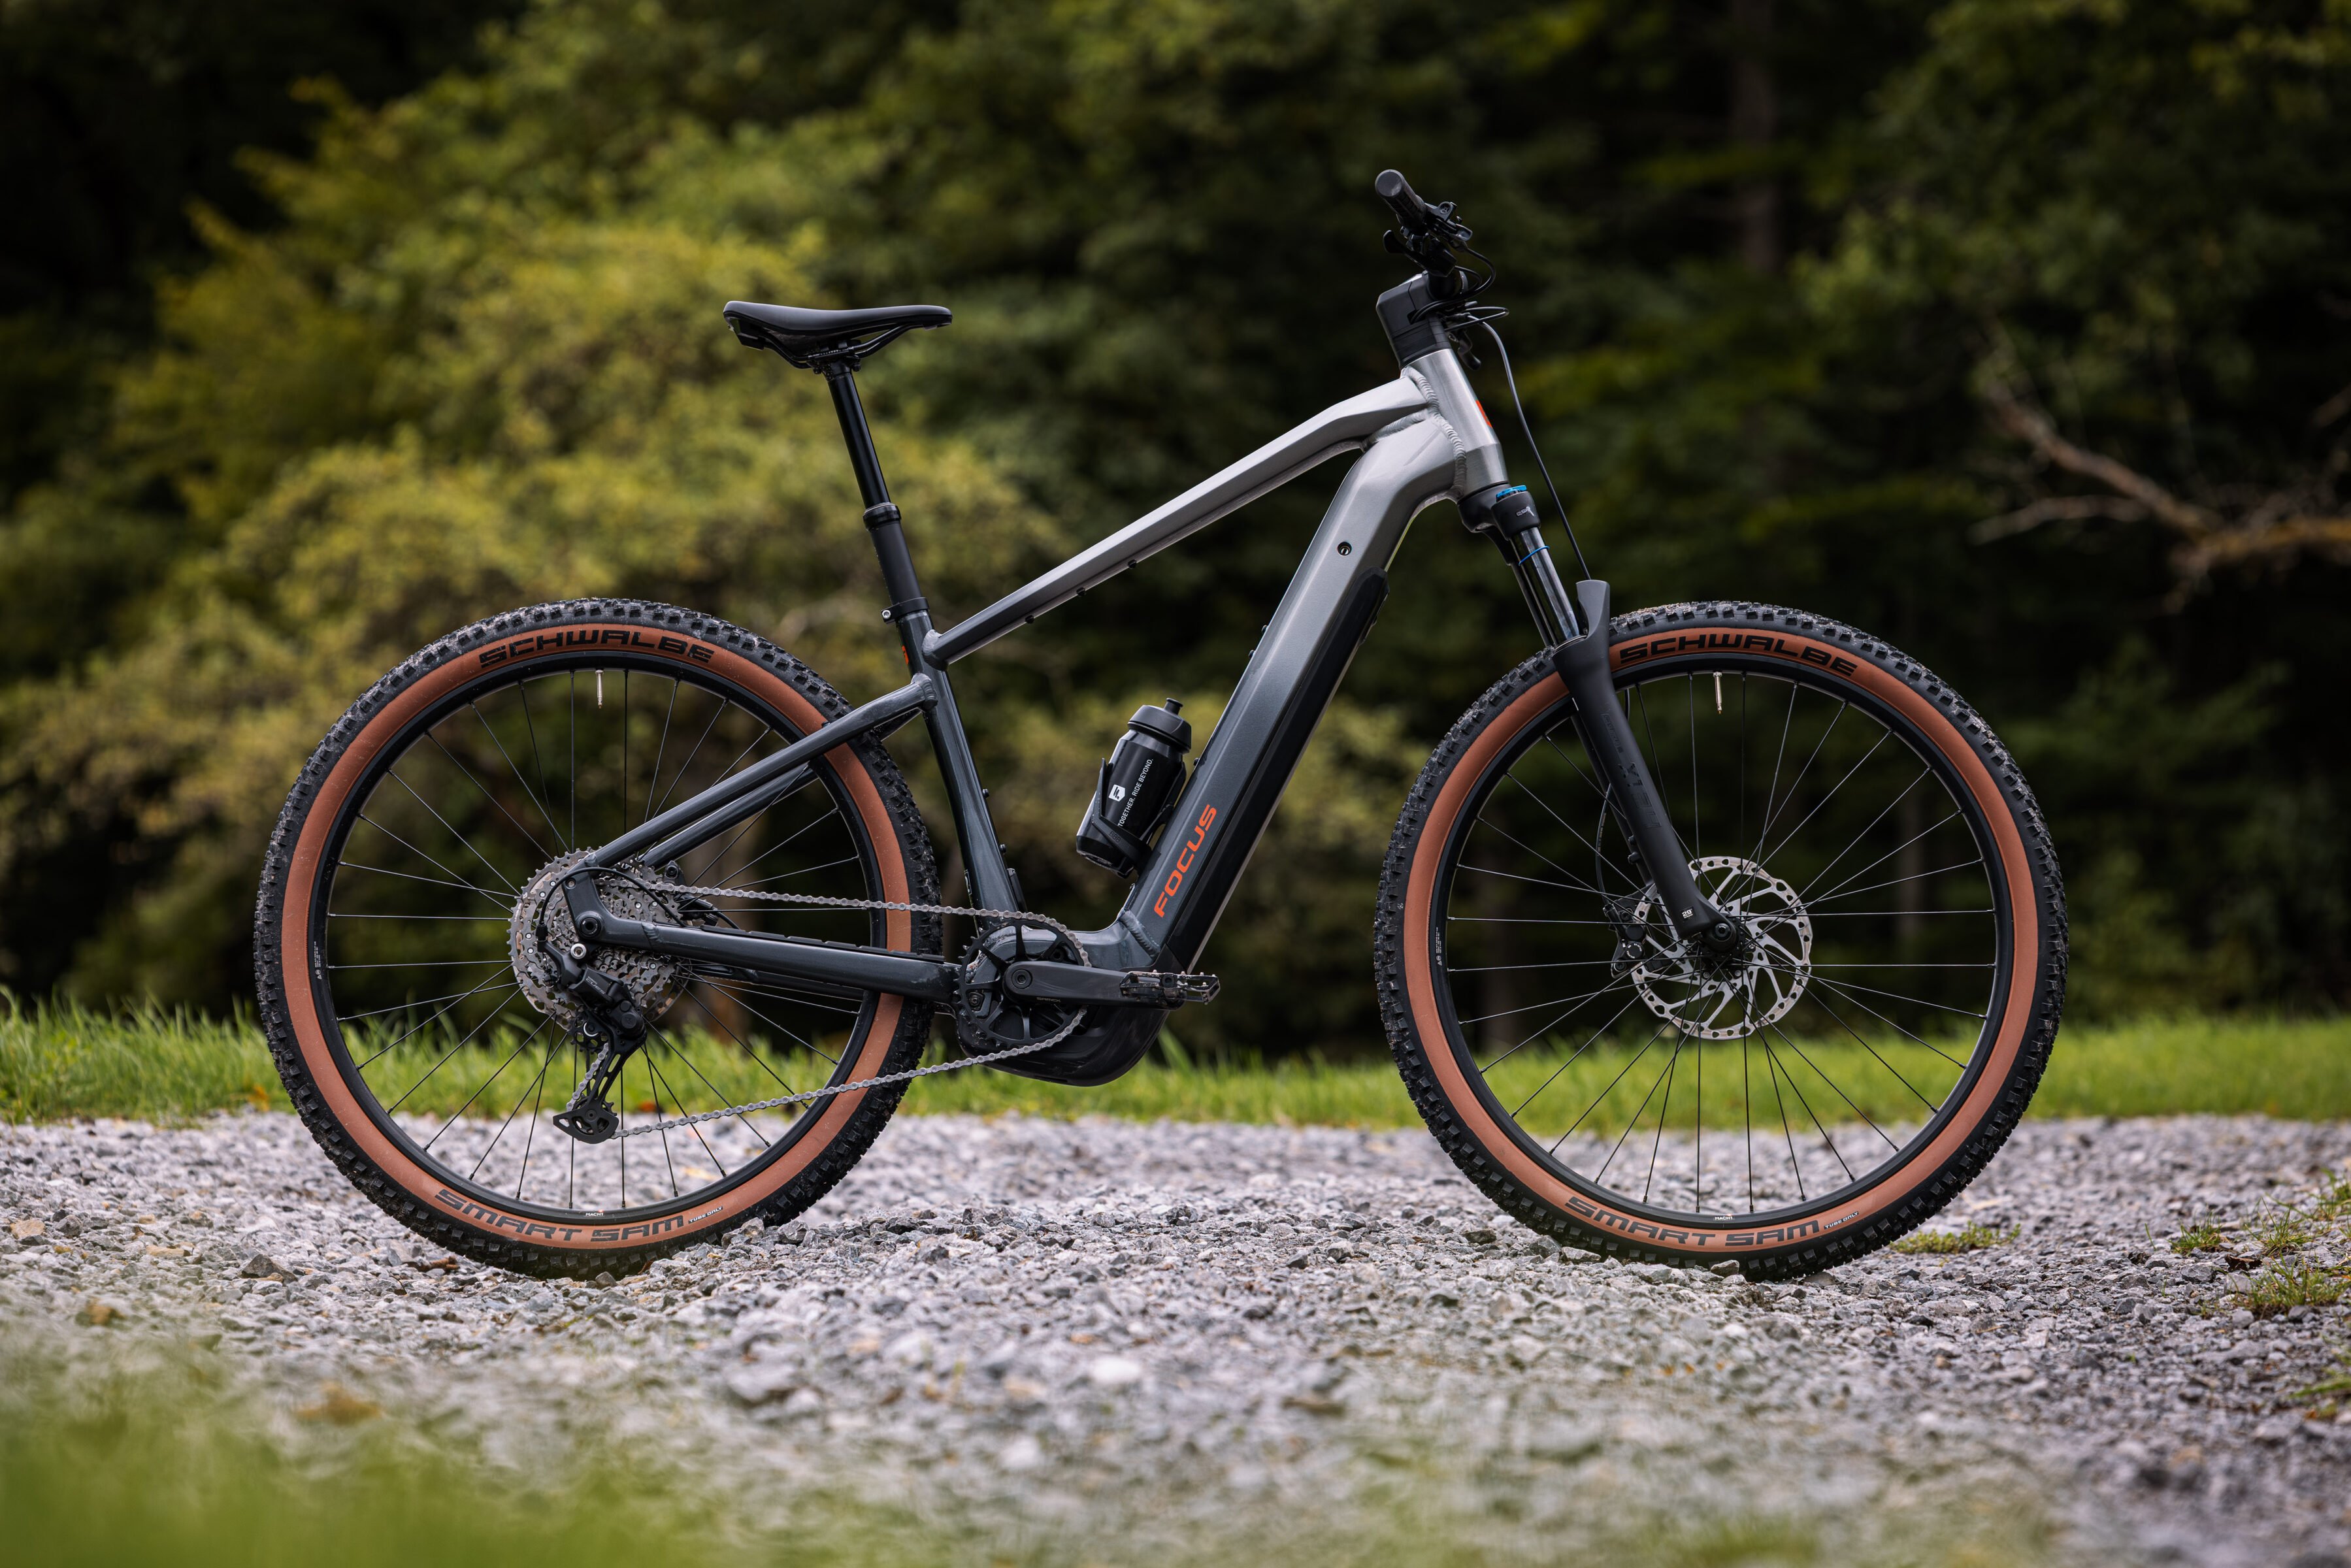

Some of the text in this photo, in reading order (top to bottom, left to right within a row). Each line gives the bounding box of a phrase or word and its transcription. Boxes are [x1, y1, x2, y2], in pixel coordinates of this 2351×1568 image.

[478, 629, 715, 668] SCHWALBE
[1619, 634, 1858, 677] SCHWALBE
[1117, 759, 1154, 827] TOGETHER. RIDE BEYOND.
[1153, 804, 1217, 919] FOCUS
[435, 1188, 684, 1243] SMART SAM
[689, 1205, 723, 1223] TUBE ONLY
[1565, 1196, 1820, 1247] SMART SAM
[1824, 1211, 1858, 1229] TUBE ONLY
